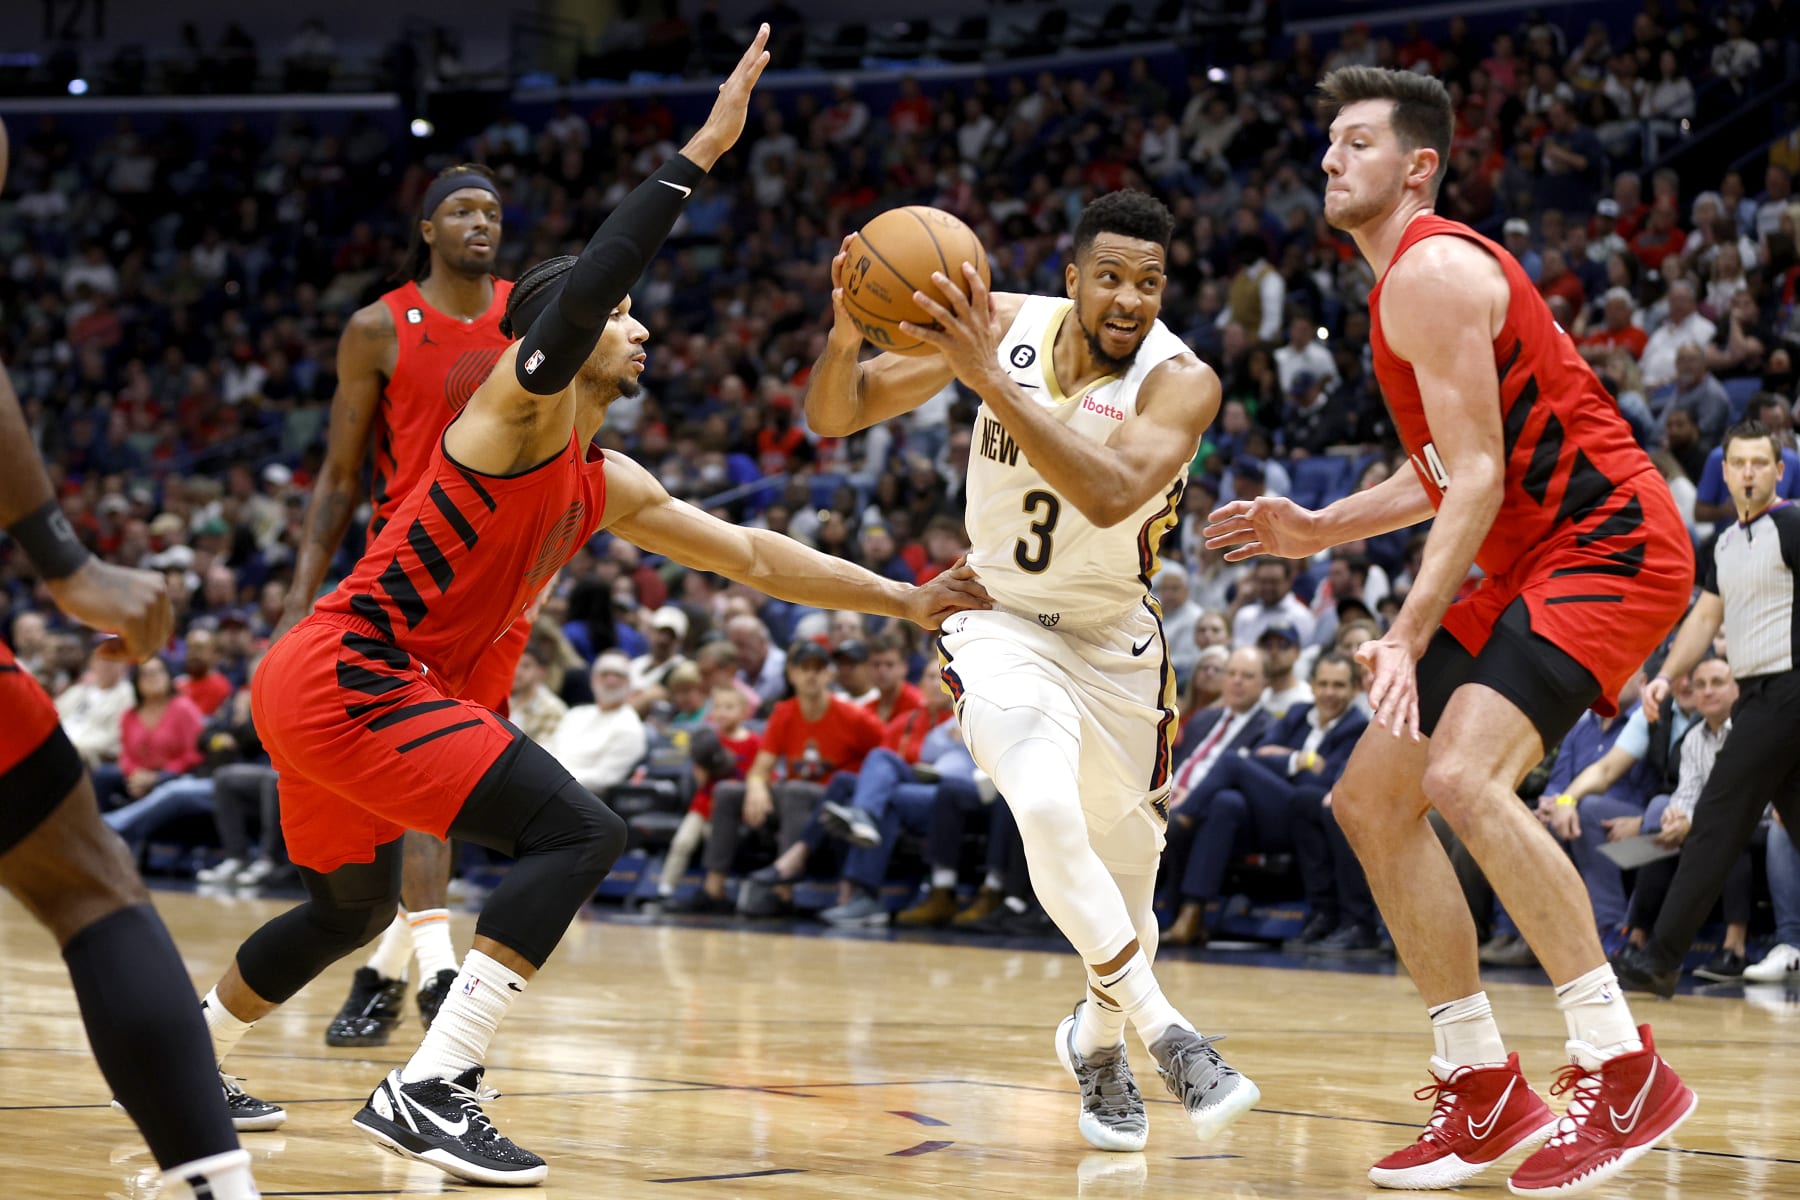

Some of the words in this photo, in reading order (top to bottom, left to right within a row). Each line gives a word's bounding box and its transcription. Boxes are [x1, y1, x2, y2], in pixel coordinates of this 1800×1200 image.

[407, 308, 423, 324] 6
[1013, 346, 1033, 367] 6
[1082, 396, 1124, 421] ibotta
[980, 416, 1020, 467] NEW
[1014, 489, 1061, 575] 3
